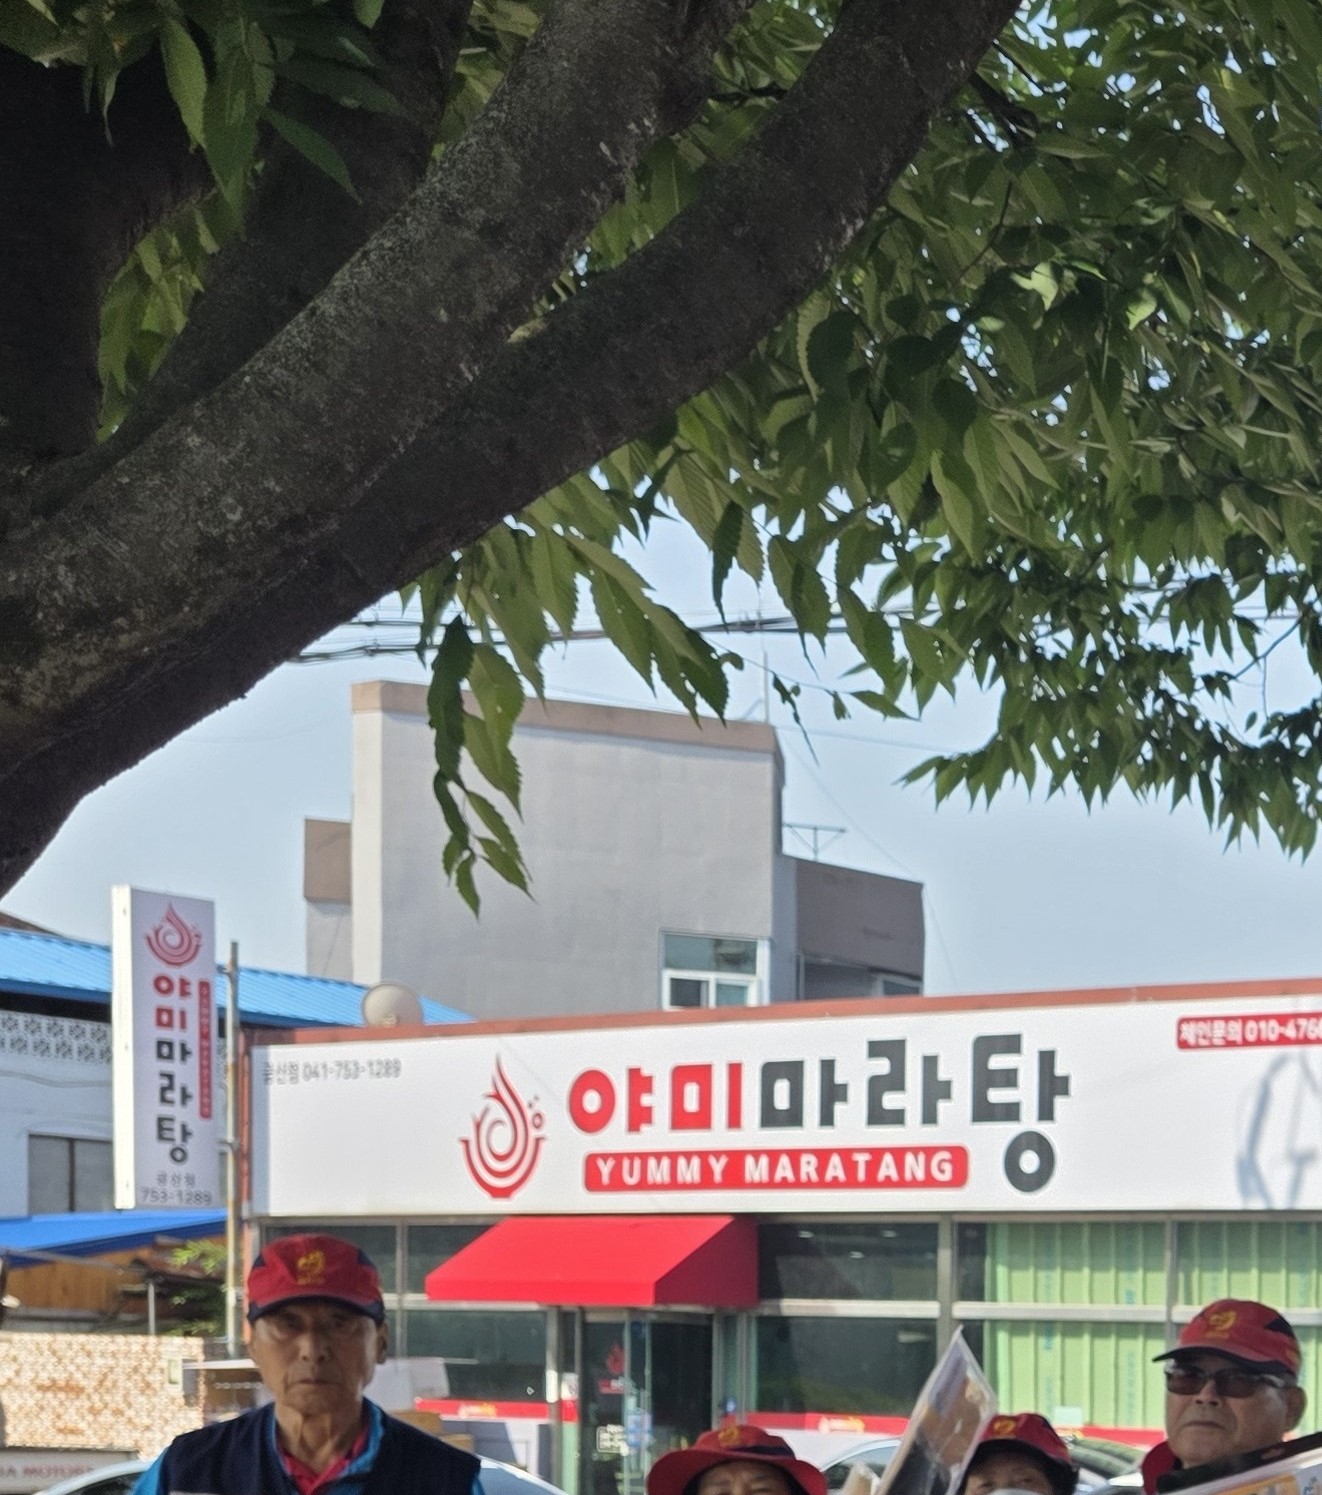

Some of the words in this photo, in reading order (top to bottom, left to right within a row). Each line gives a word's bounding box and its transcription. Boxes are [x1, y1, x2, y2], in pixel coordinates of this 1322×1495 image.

[152, 974, 194, 1164] 야미마라탕
[567, 1033, 1072, 1193] 야미마라탕
[596, 1155, 730, 1186] YUMMY
[744, 1150, 955, 1184] MARATANG
